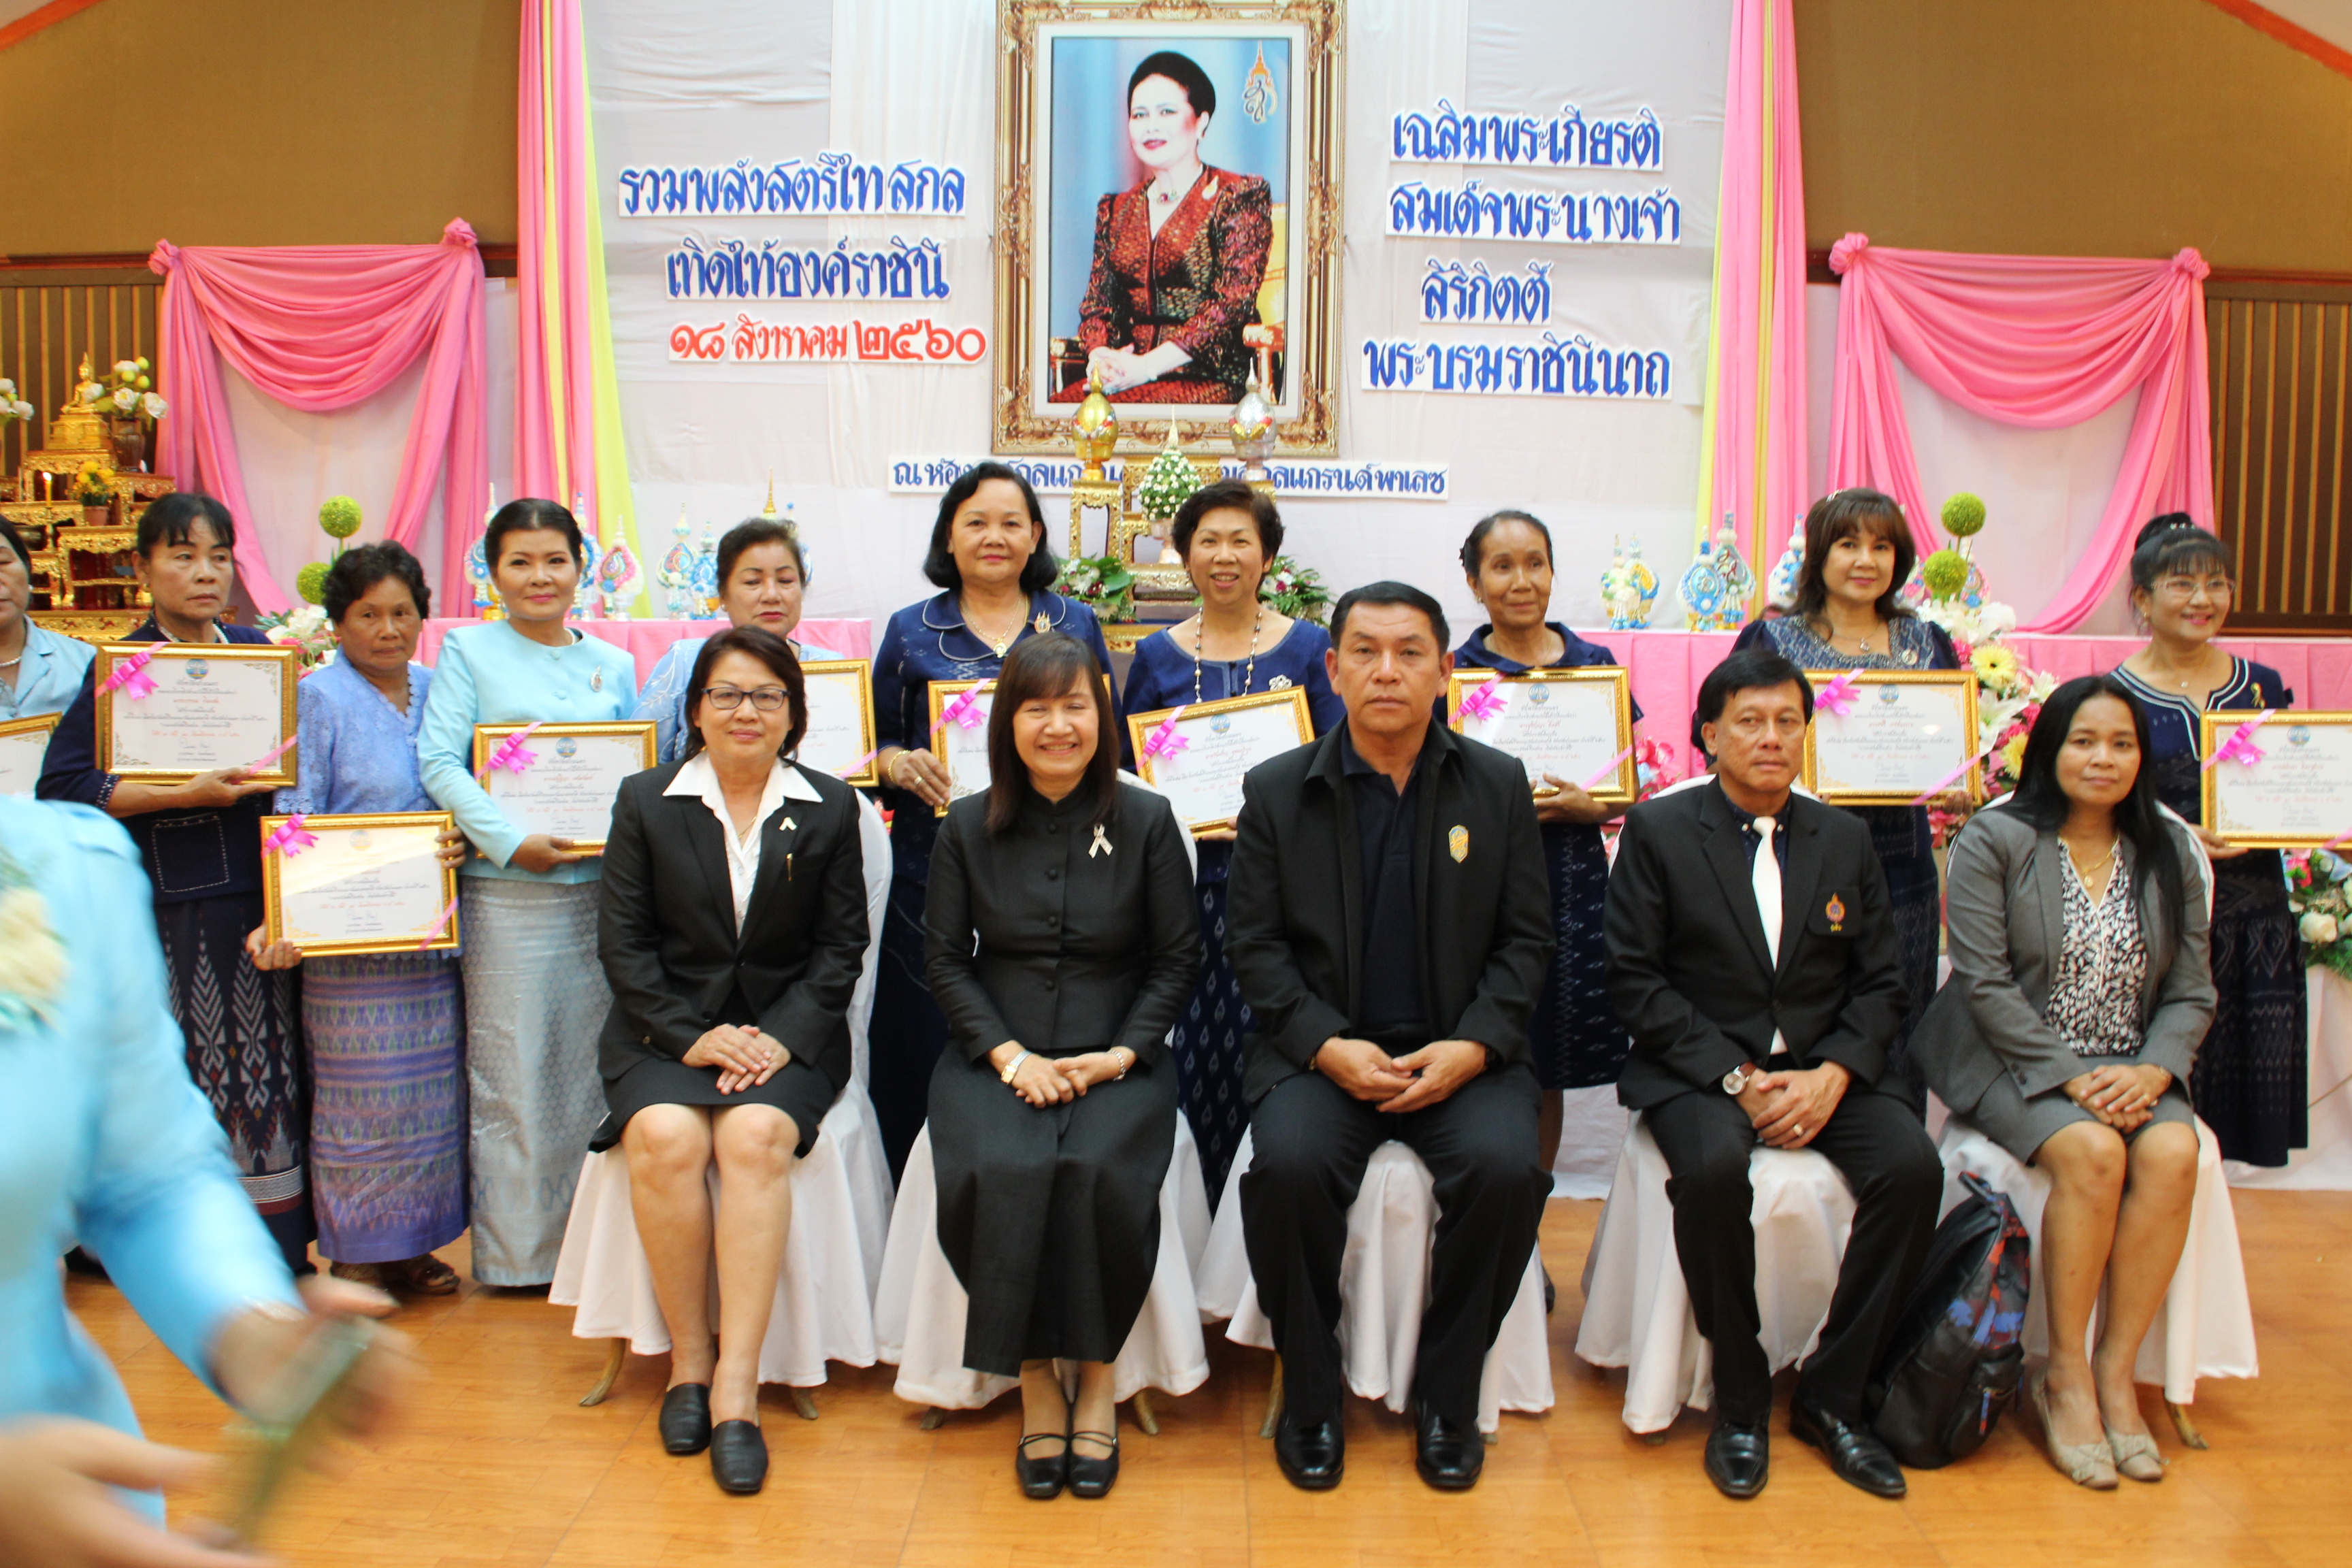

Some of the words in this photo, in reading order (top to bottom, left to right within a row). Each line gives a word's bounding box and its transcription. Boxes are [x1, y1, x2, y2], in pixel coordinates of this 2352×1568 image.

[1393, 97, 1661, 167] เฉลิมพระเกียรติ
[1390, 179, 1680, 242] สมเด็จพระนางเจ้า
[732, 314, 848, 360] สิงหาคม
[852, 318, 987, 361] ๒๕๖๐
[1363, 331, 1671, 397] พระบรมราชินีนาถ
